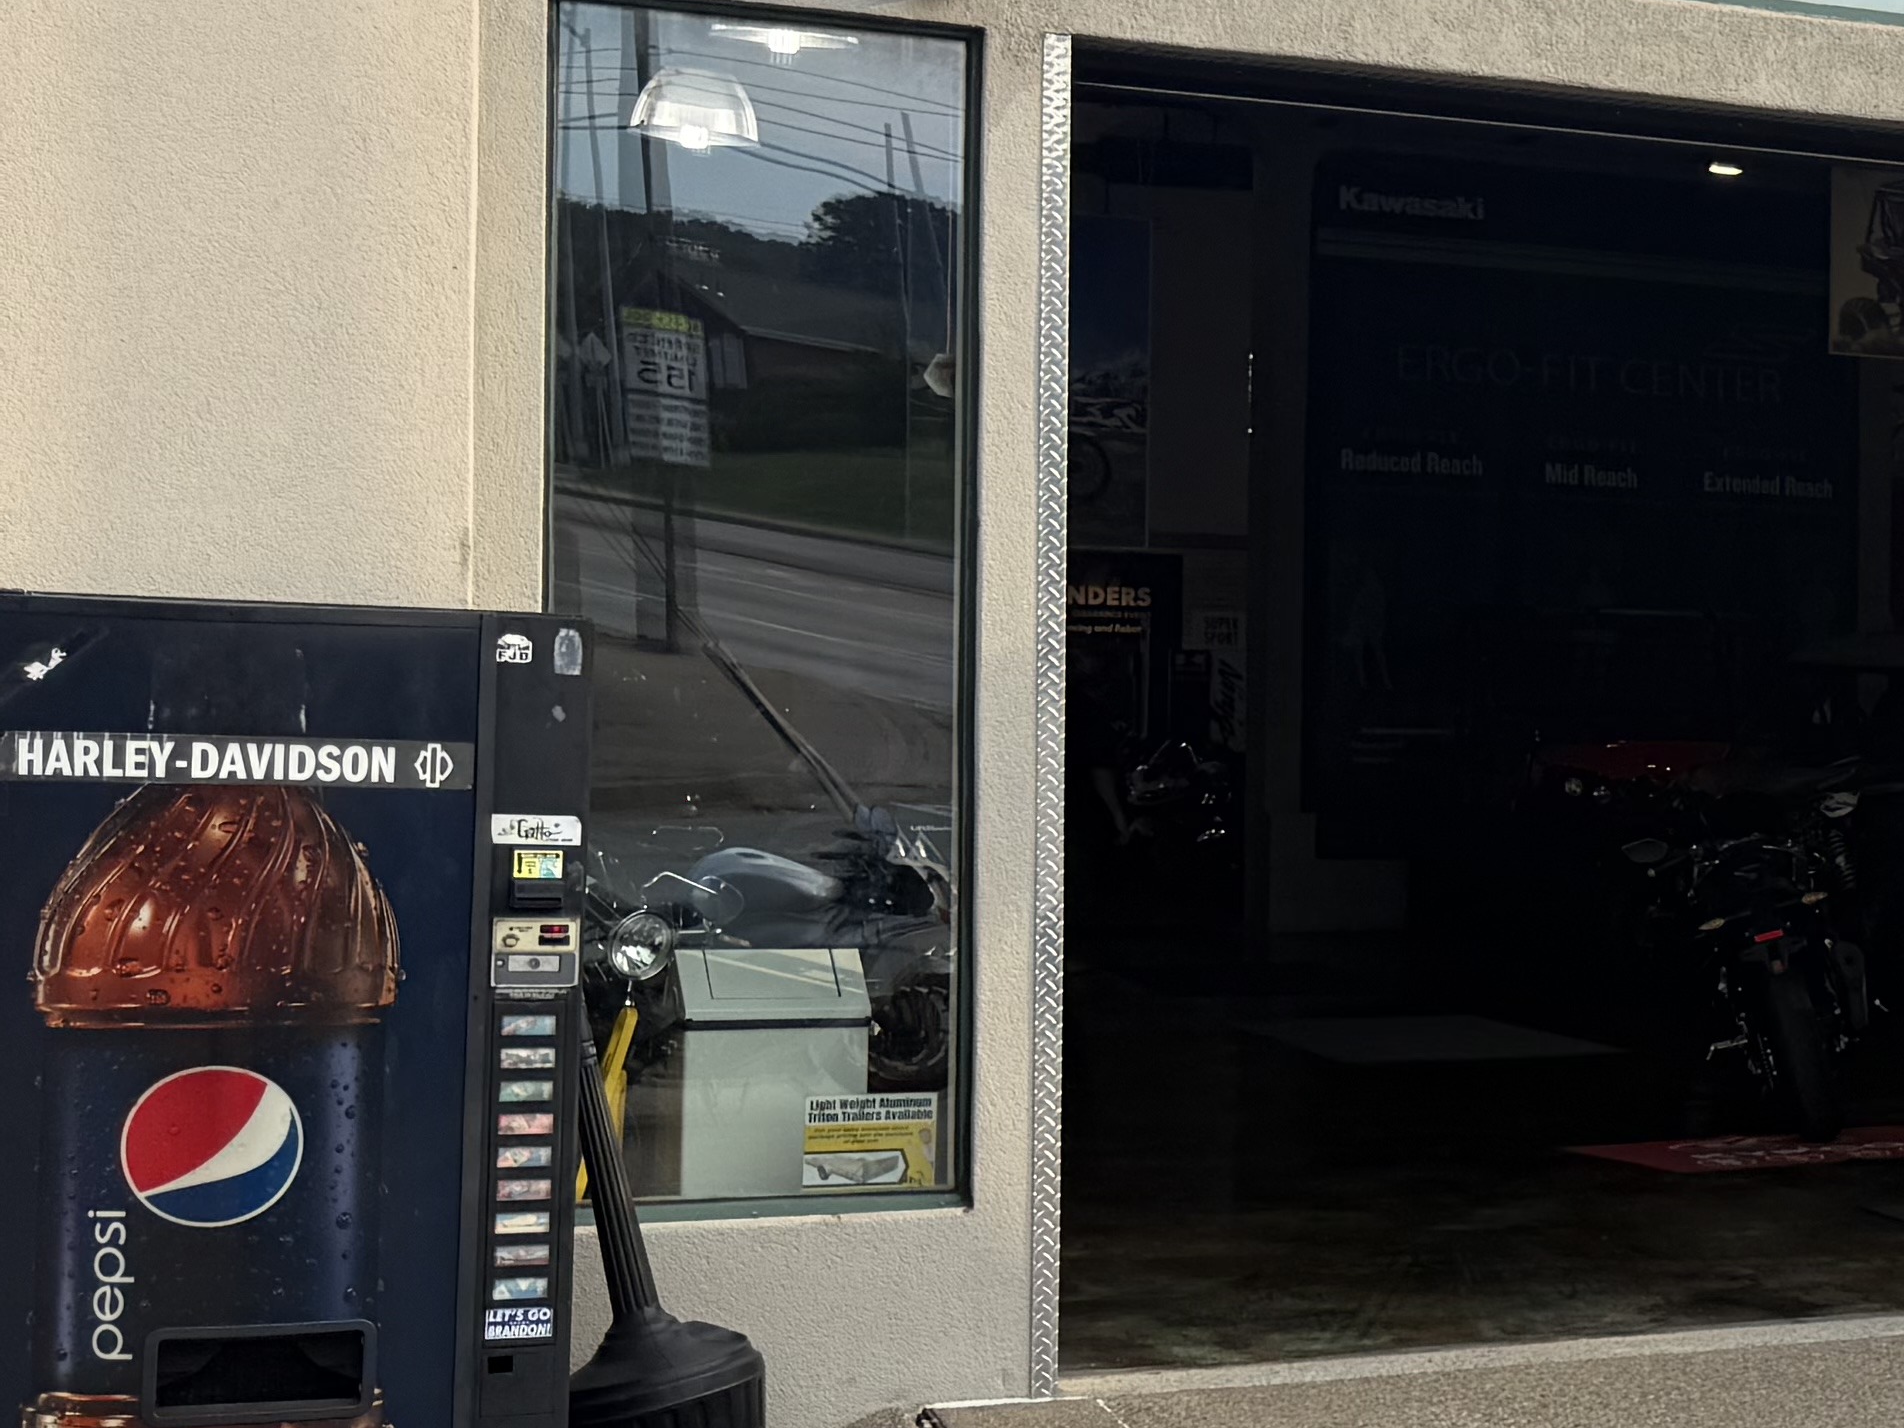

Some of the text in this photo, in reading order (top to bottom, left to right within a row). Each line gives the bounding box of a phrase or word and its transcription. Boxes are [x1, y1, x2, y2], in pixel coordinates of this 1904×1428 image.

[1338, 185, 1485, 220] Kawasaki
[1545, 461, 1638, 490] Mid Reach
[18, 739, 396, 783] HARLEY-DAVIDSON
[810, 1097, 932, 1112] Light Weight Aluminum
[885, 1109, 933, 1120] Available
[88, 1209, 134, 1360] pepsi
[489, 1307, 550, 1322] LET'S GO
[488, 1323, 551, 1337] BRANDON!
